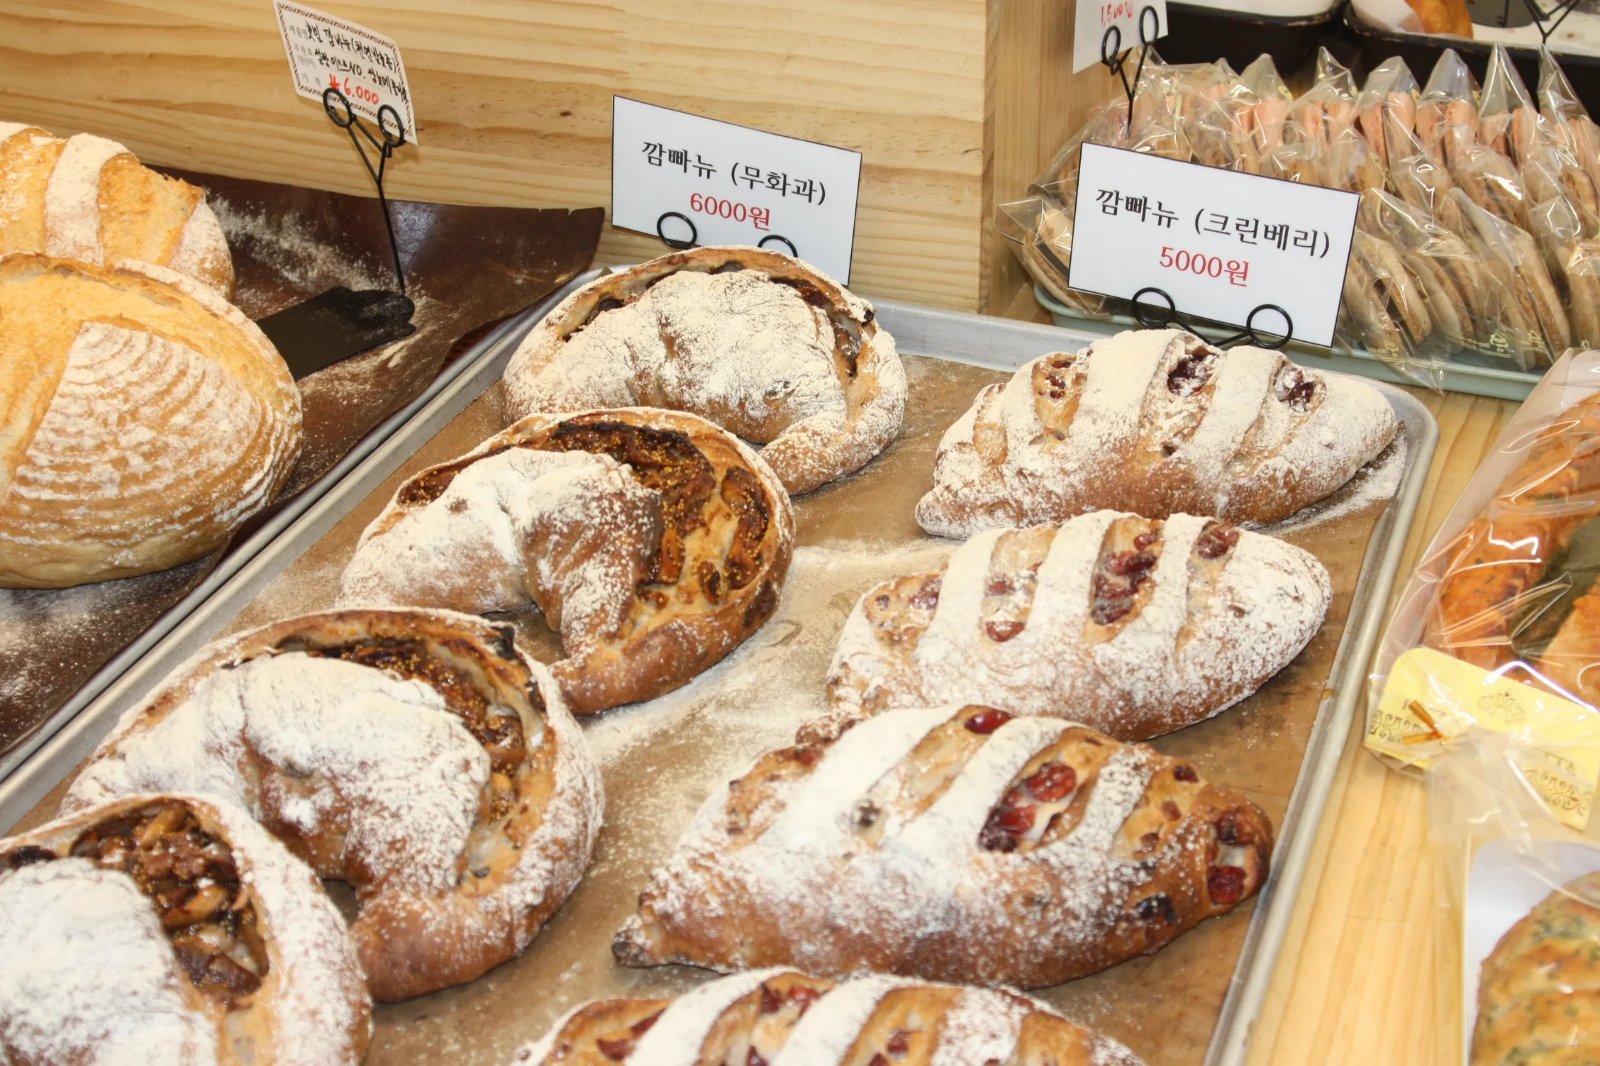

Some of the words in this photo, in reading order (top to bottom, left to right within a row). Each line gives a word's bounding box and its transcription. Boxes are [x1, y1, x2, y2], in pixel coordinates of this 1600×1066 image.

[642, 141, 717, 180] 깜빠뉴
[731, 162, 826, 206] (무화과)
[690, 192, 771, 231] 6000원
[1096, 189, 1179, 229] 깜빠뉴
[1194, 208, 1331, 259] (크린베리)
[1159, 246, 1250, 287] 5000원
